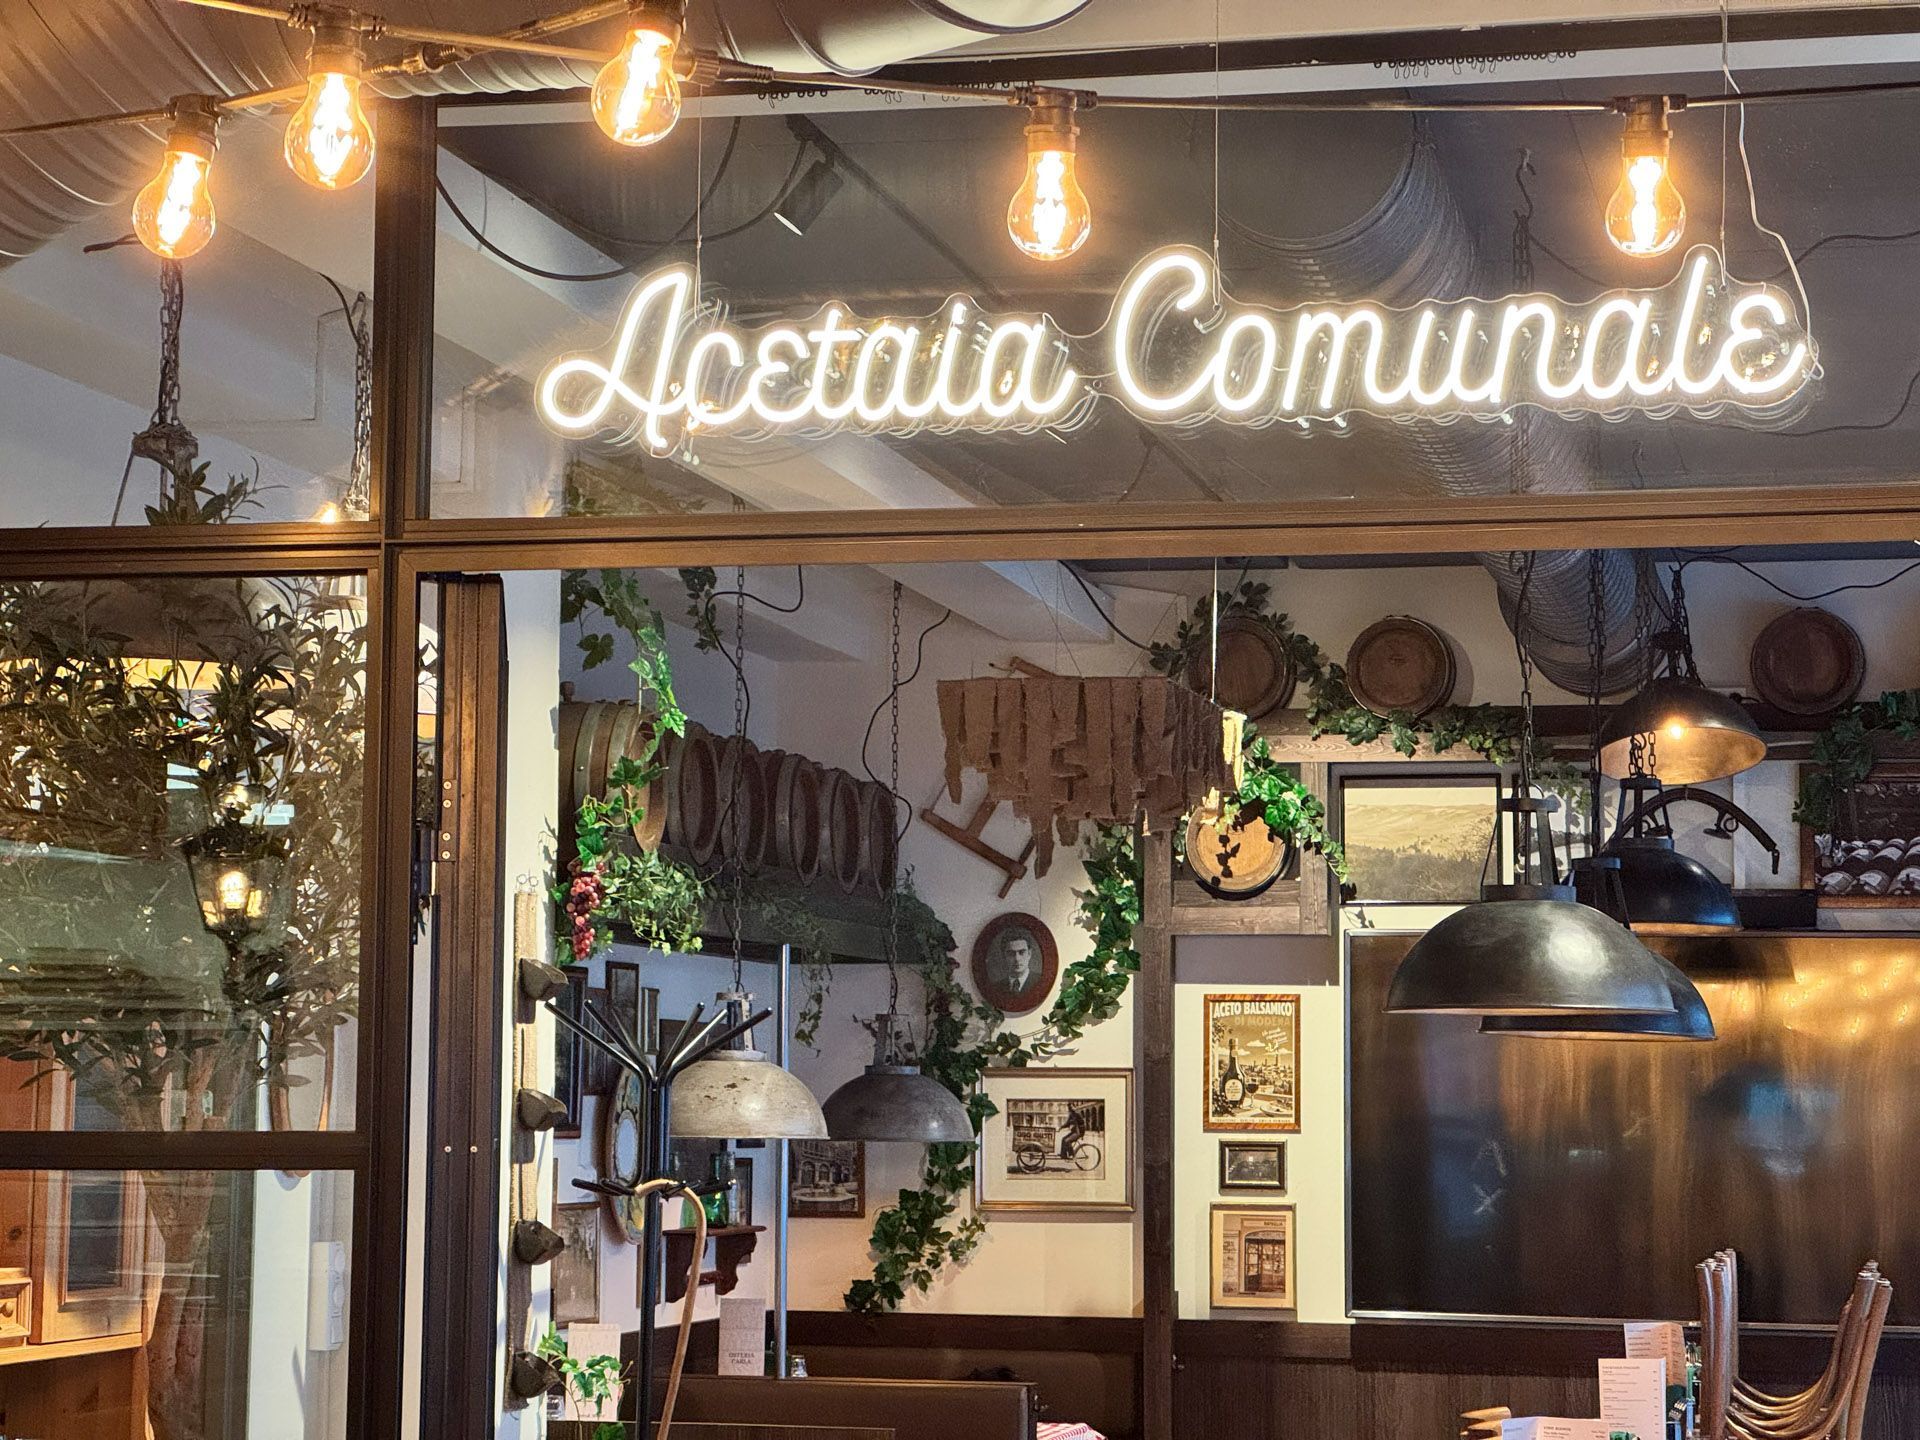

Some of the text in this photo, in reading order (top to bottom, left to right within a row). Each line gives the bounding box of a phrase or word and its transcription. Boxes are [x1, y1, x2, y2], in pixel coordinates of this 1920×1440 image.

[542, 253, 1807, 448] Acetaia Comunale
[1214, 1002, 1293, 1018] ACETO BALSAMICO
[1247, 1015, 1291, 1026] MODENA
